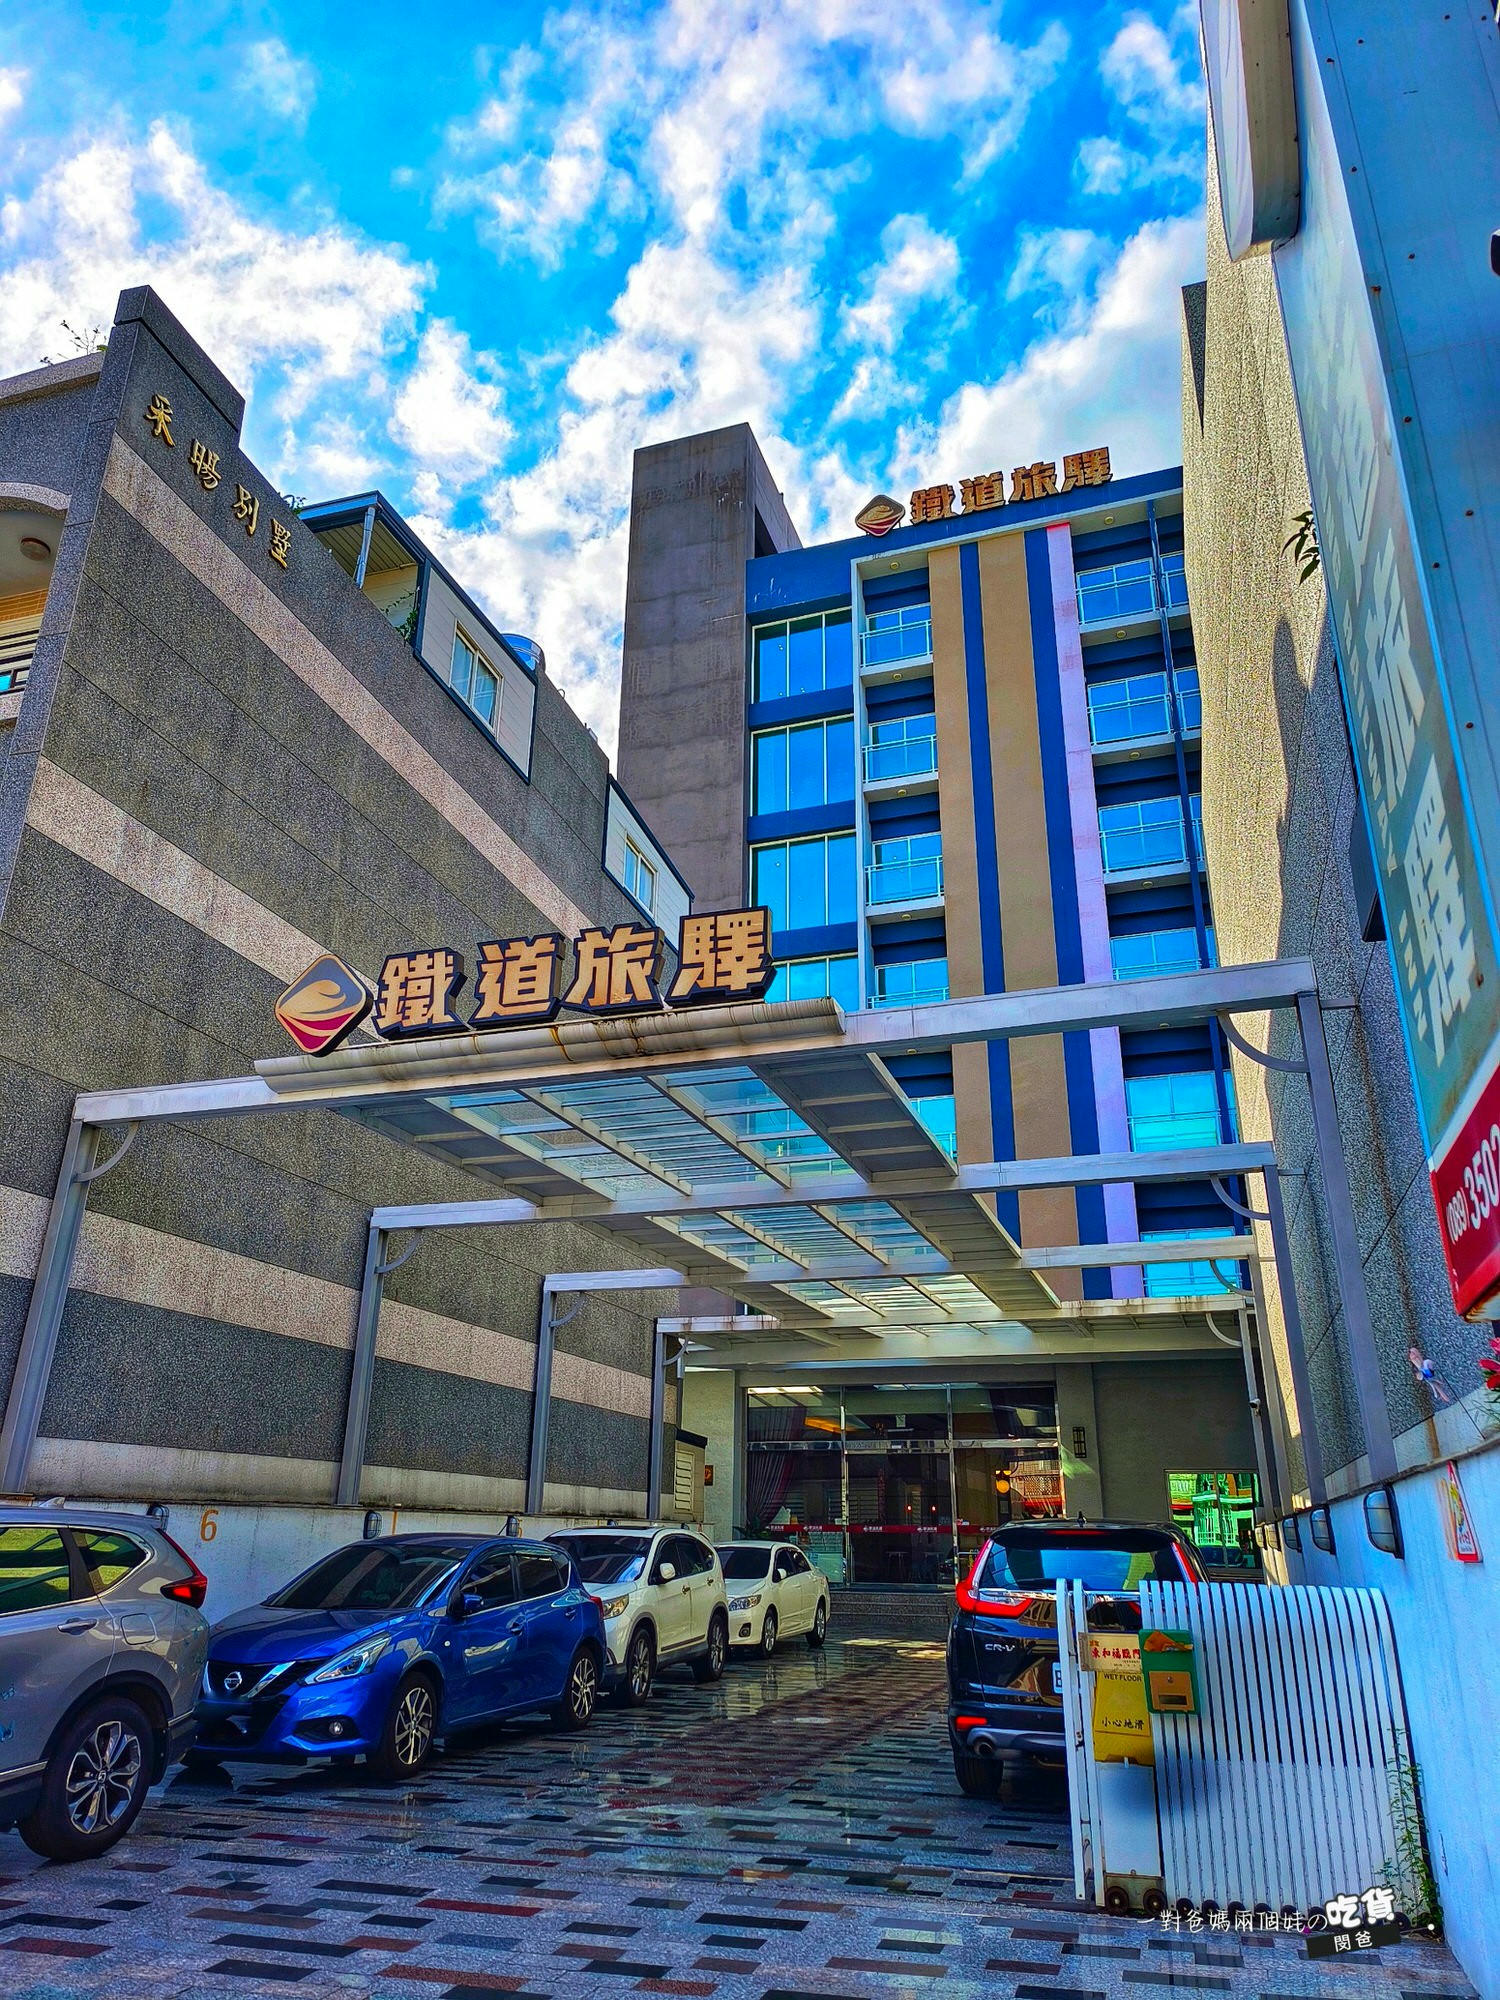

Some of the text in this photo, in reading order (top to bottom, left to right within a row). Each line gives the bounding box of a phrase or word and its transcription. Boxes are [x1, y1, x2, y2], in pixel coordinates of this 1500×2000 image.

[911, 447, 1113, 525] 鐵道旅驛
[1343, 600, 1398, 877] RAILWAY
[1399, 909, 1428, 1041] INN
[373, 908, 772, 1036] 鐵道旅驛
[1446, 1187, 1470, 1244] (089)
[200, 1508, 219, 1542] 6
[985, 1643, 1015, 1652] CR-V
[1104, 1673, 1142, 1682] WET FLOOR
[1102, 1717, 1144, 1730] 小心地滑
